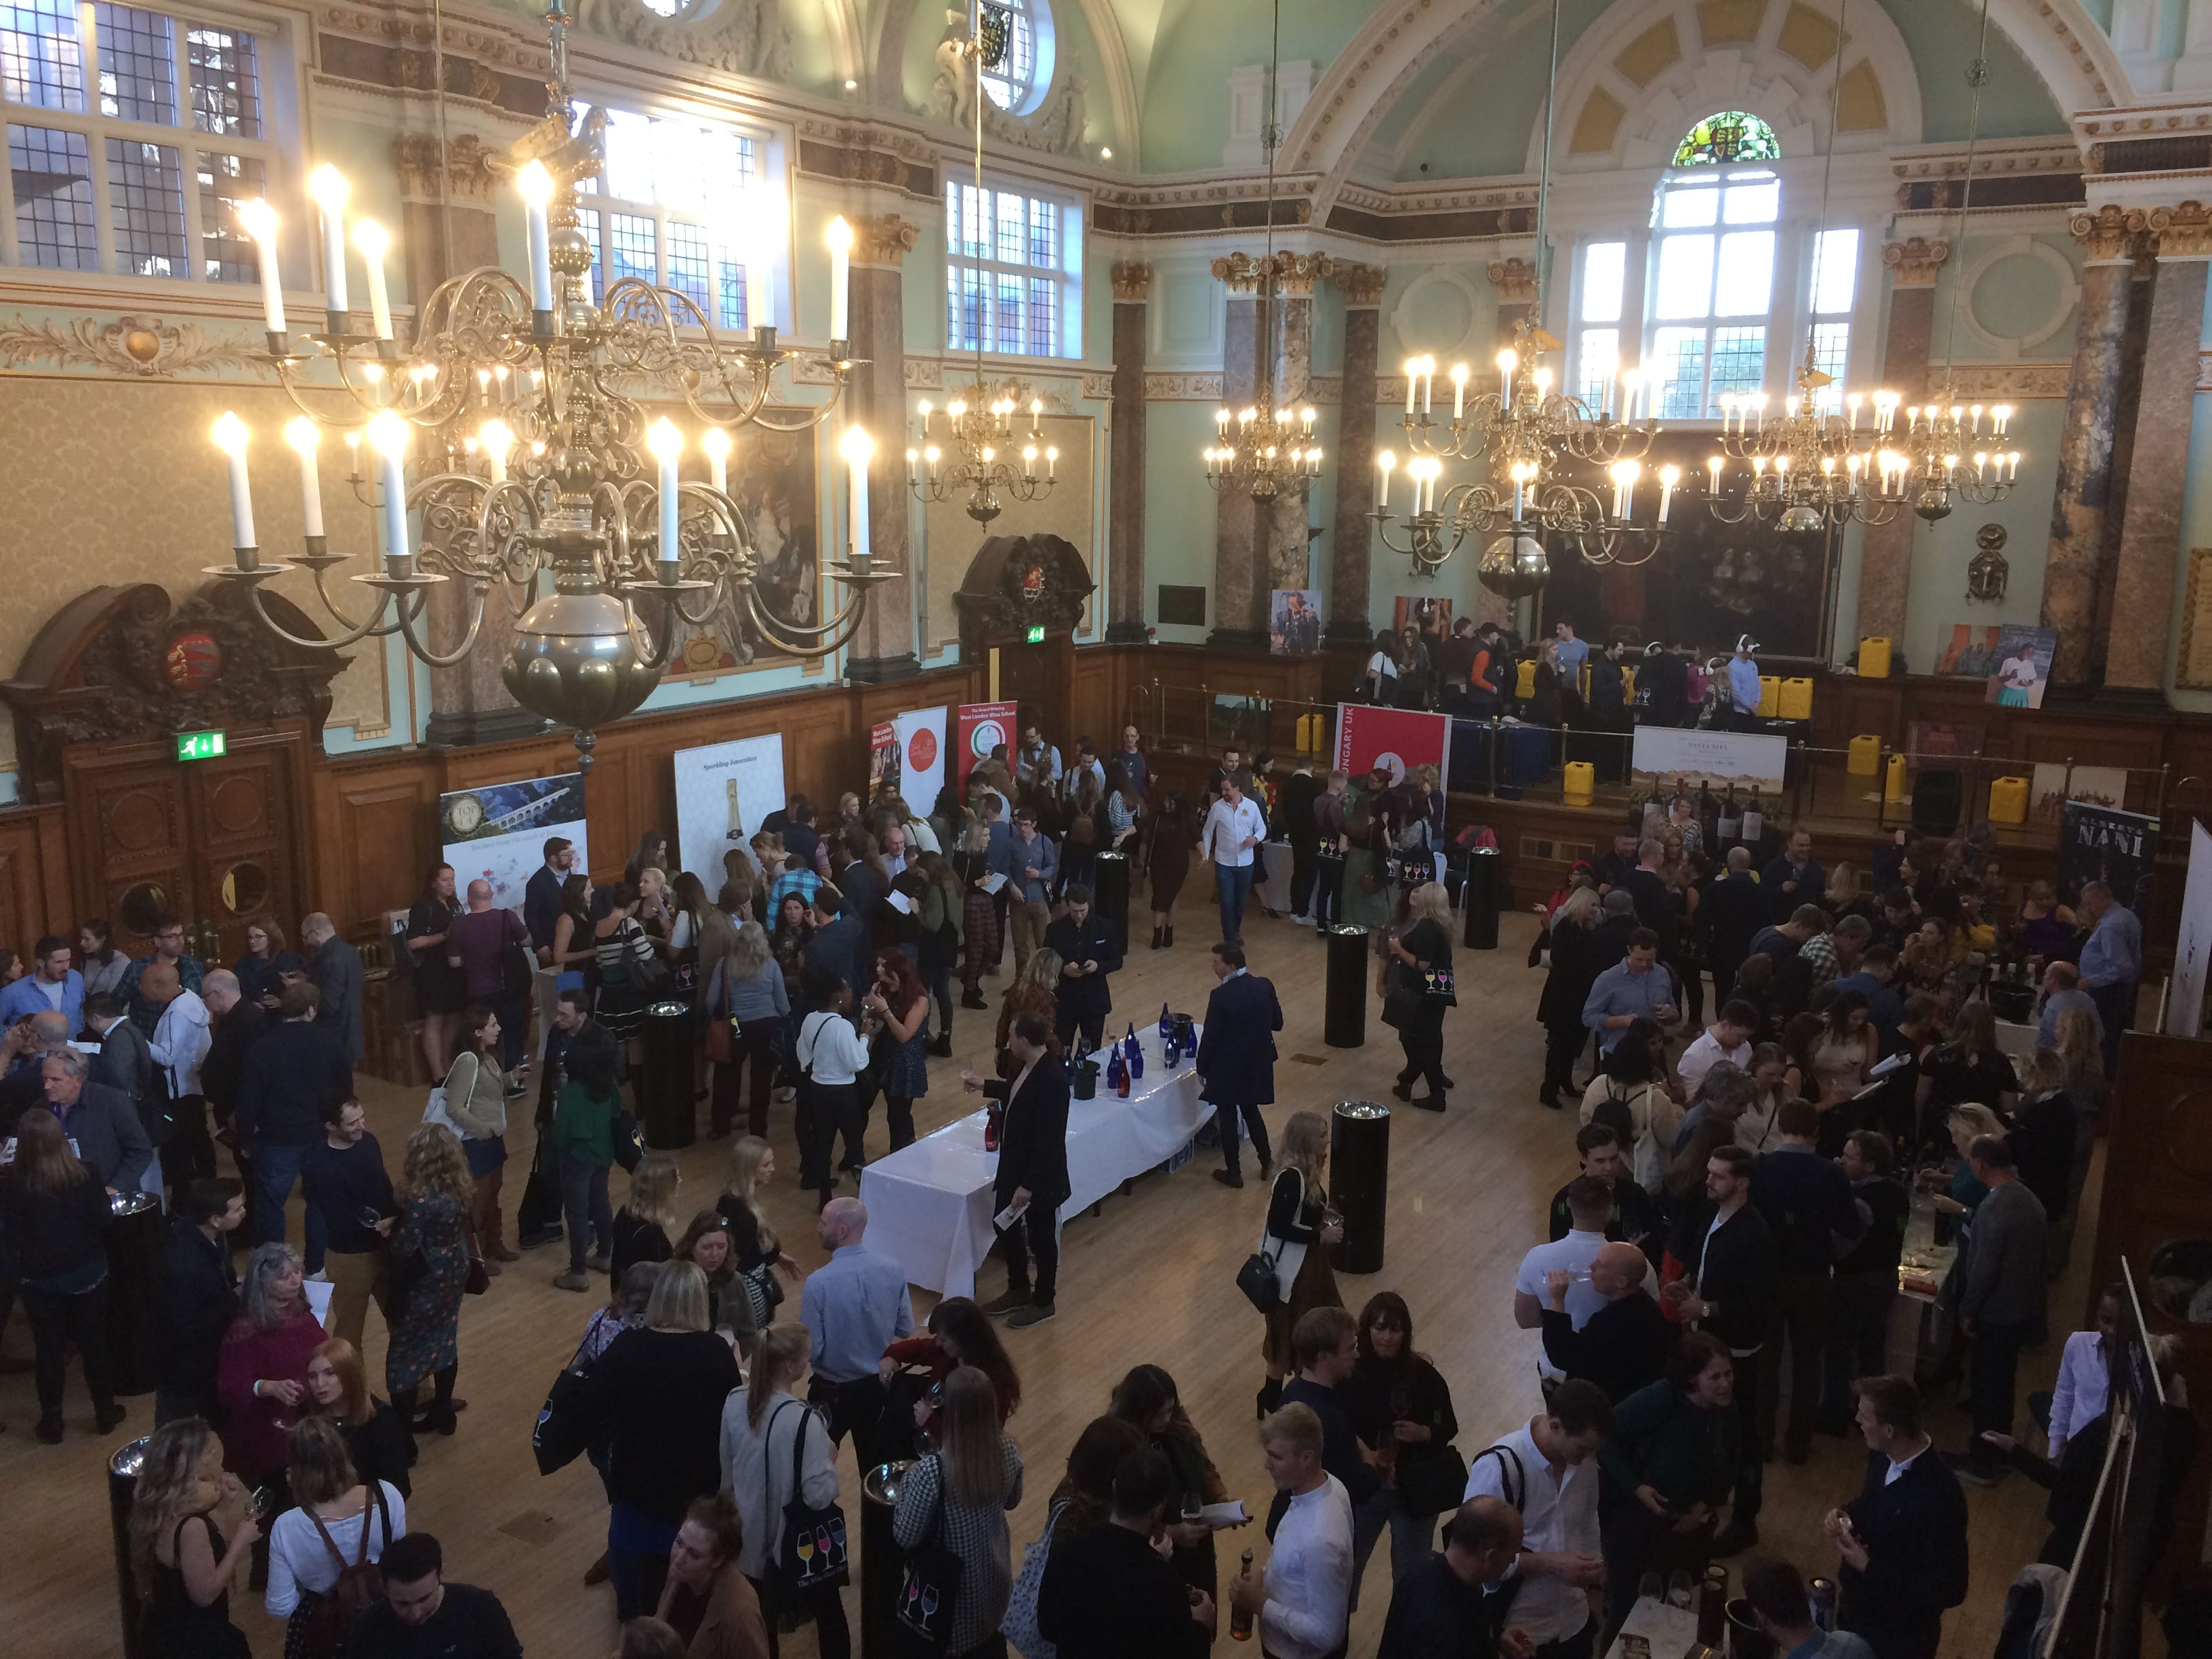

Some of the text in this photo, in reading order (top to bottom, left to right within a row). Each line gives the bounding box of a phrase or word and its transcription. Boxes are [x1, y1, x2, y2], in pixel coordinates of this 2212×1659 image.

[880, 726, 893, 735] London
[872, 732, 893, 745] Wine School
[1342, 708, 1353, 774] UNGARY UK
[2076, 824, 2144, 857] NANI
[796, 1580, 810, 1588] The
